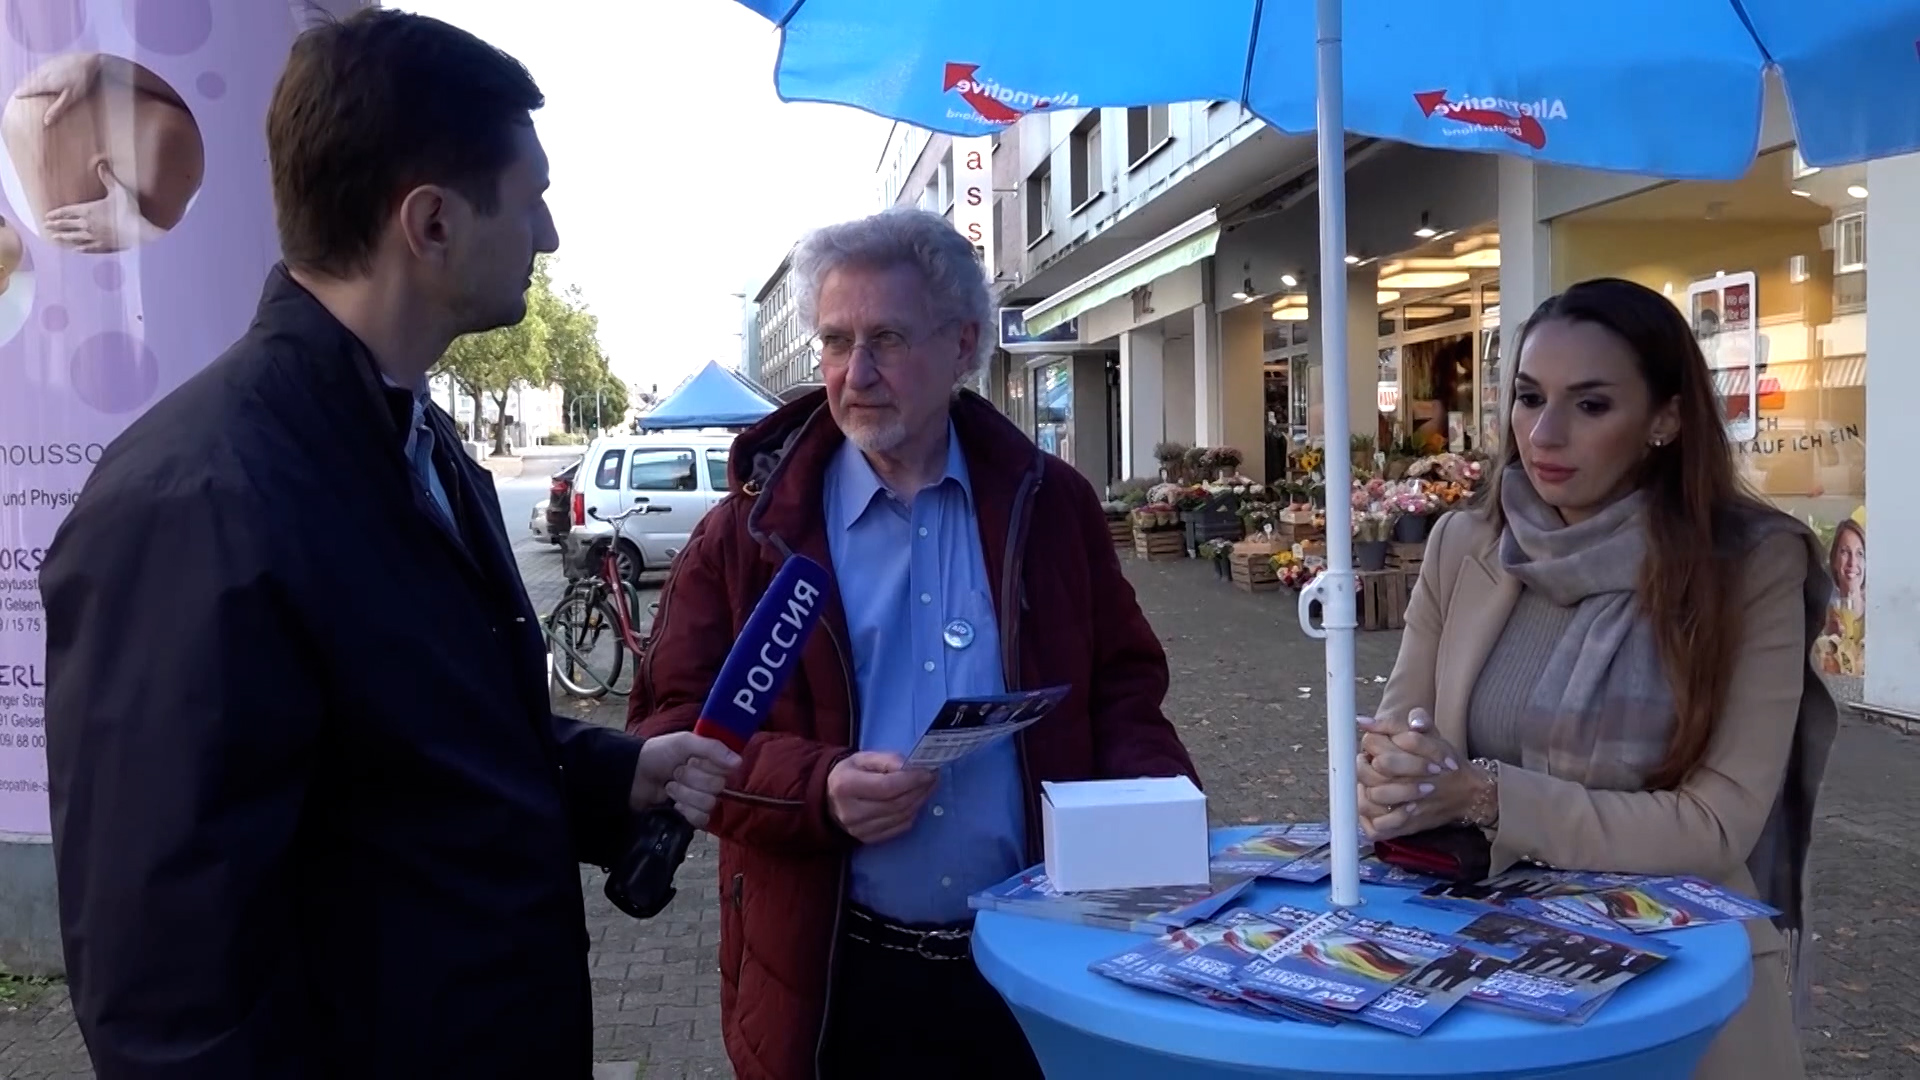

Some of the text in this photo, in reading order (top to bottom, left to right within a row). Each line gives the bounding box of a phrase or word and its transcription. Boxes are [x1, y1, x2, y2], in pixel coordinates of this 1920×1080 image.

[1738, 423, 1859, 454] KAUF ICH EIN
[3, 489, 26, 506] und
[733, 579, 820, 715] РОССИЯ
[16, 733, 29, 748] 88
